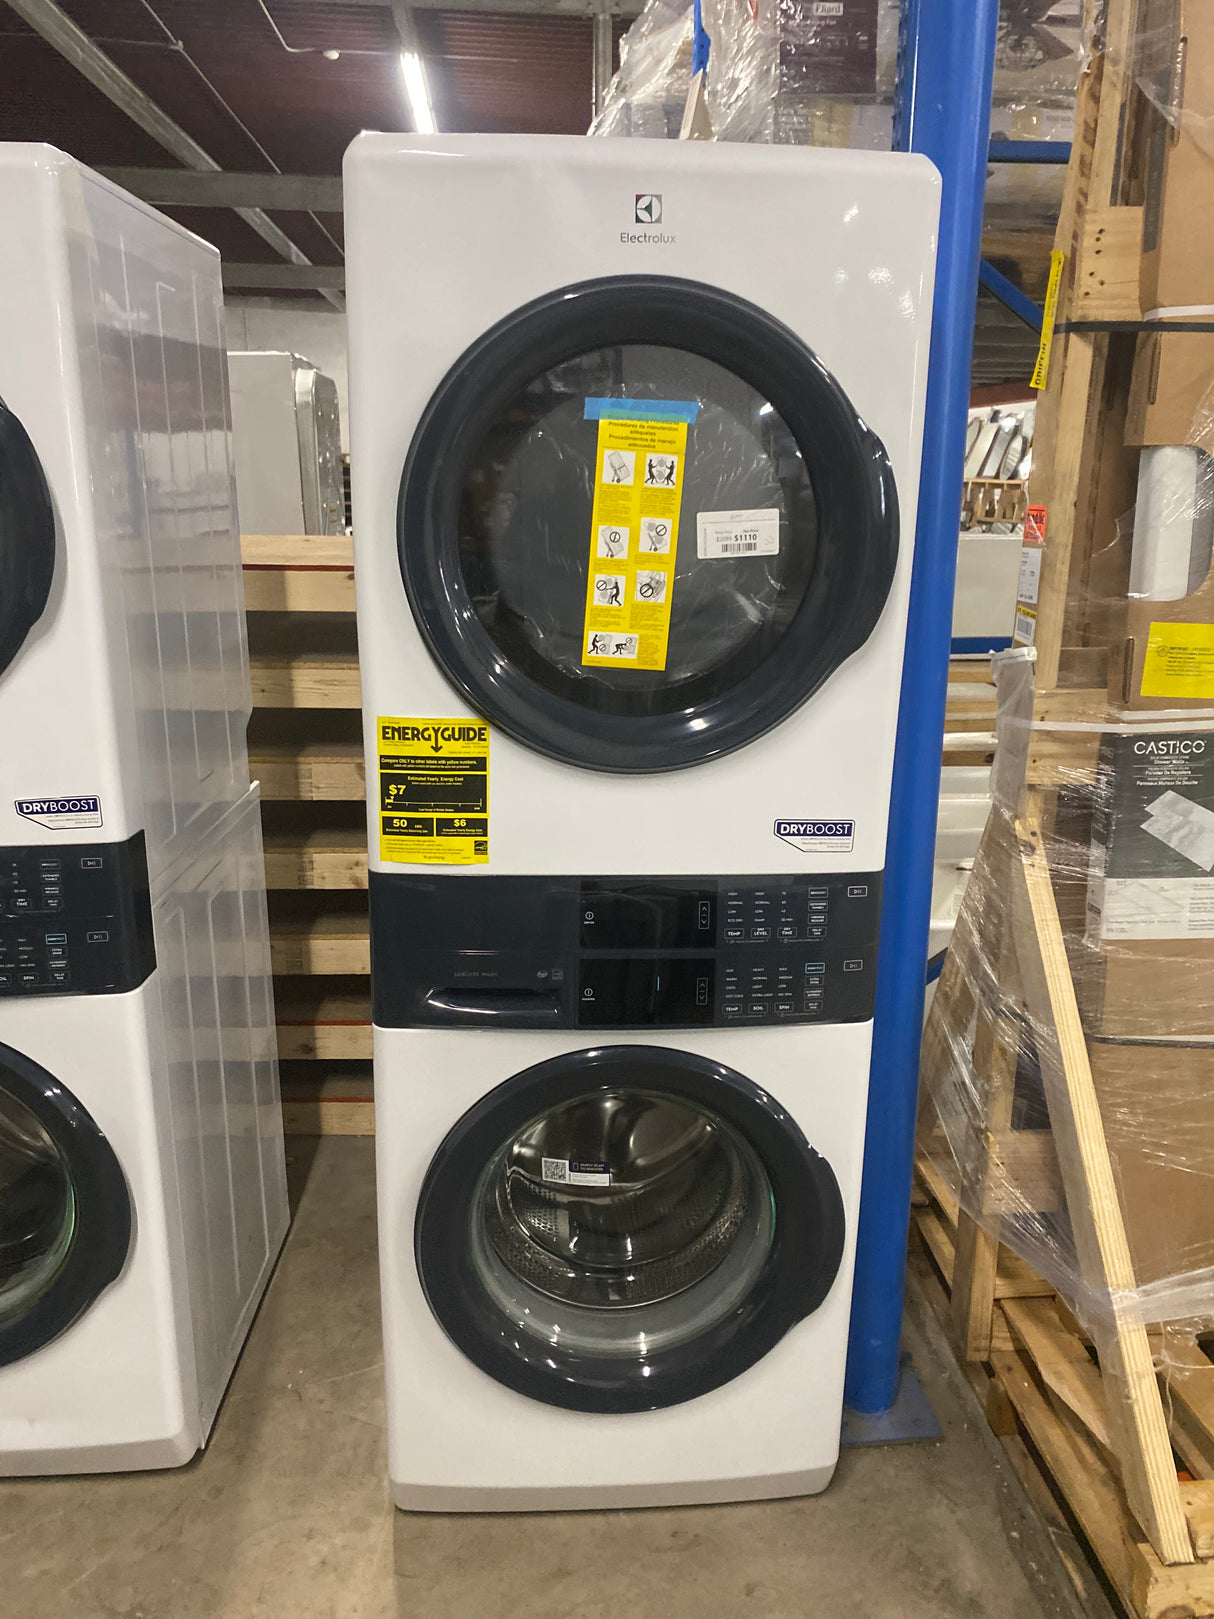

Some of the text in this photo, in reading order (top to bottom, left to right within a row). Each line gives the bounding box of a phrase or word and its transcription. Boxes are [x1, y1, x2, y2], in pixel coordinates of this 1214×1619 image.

[620, 232, 677, 244] Electrolux
[1035, 343, 1047, 386] GRIFFIN
[734, 533, 758, 542] $1110
[382, 726, 487, 741] ENERGYGUIDE
[1134, 740, 1205, 755] CASTICO
[388, 784, 406, 795] $7
[22, 800, 95, 813] DRYBOOST
[393, 818, 408, 828] 50
[453, 818, 467, 827] $6
[780, 824, 851, 835] DRYBOOST
